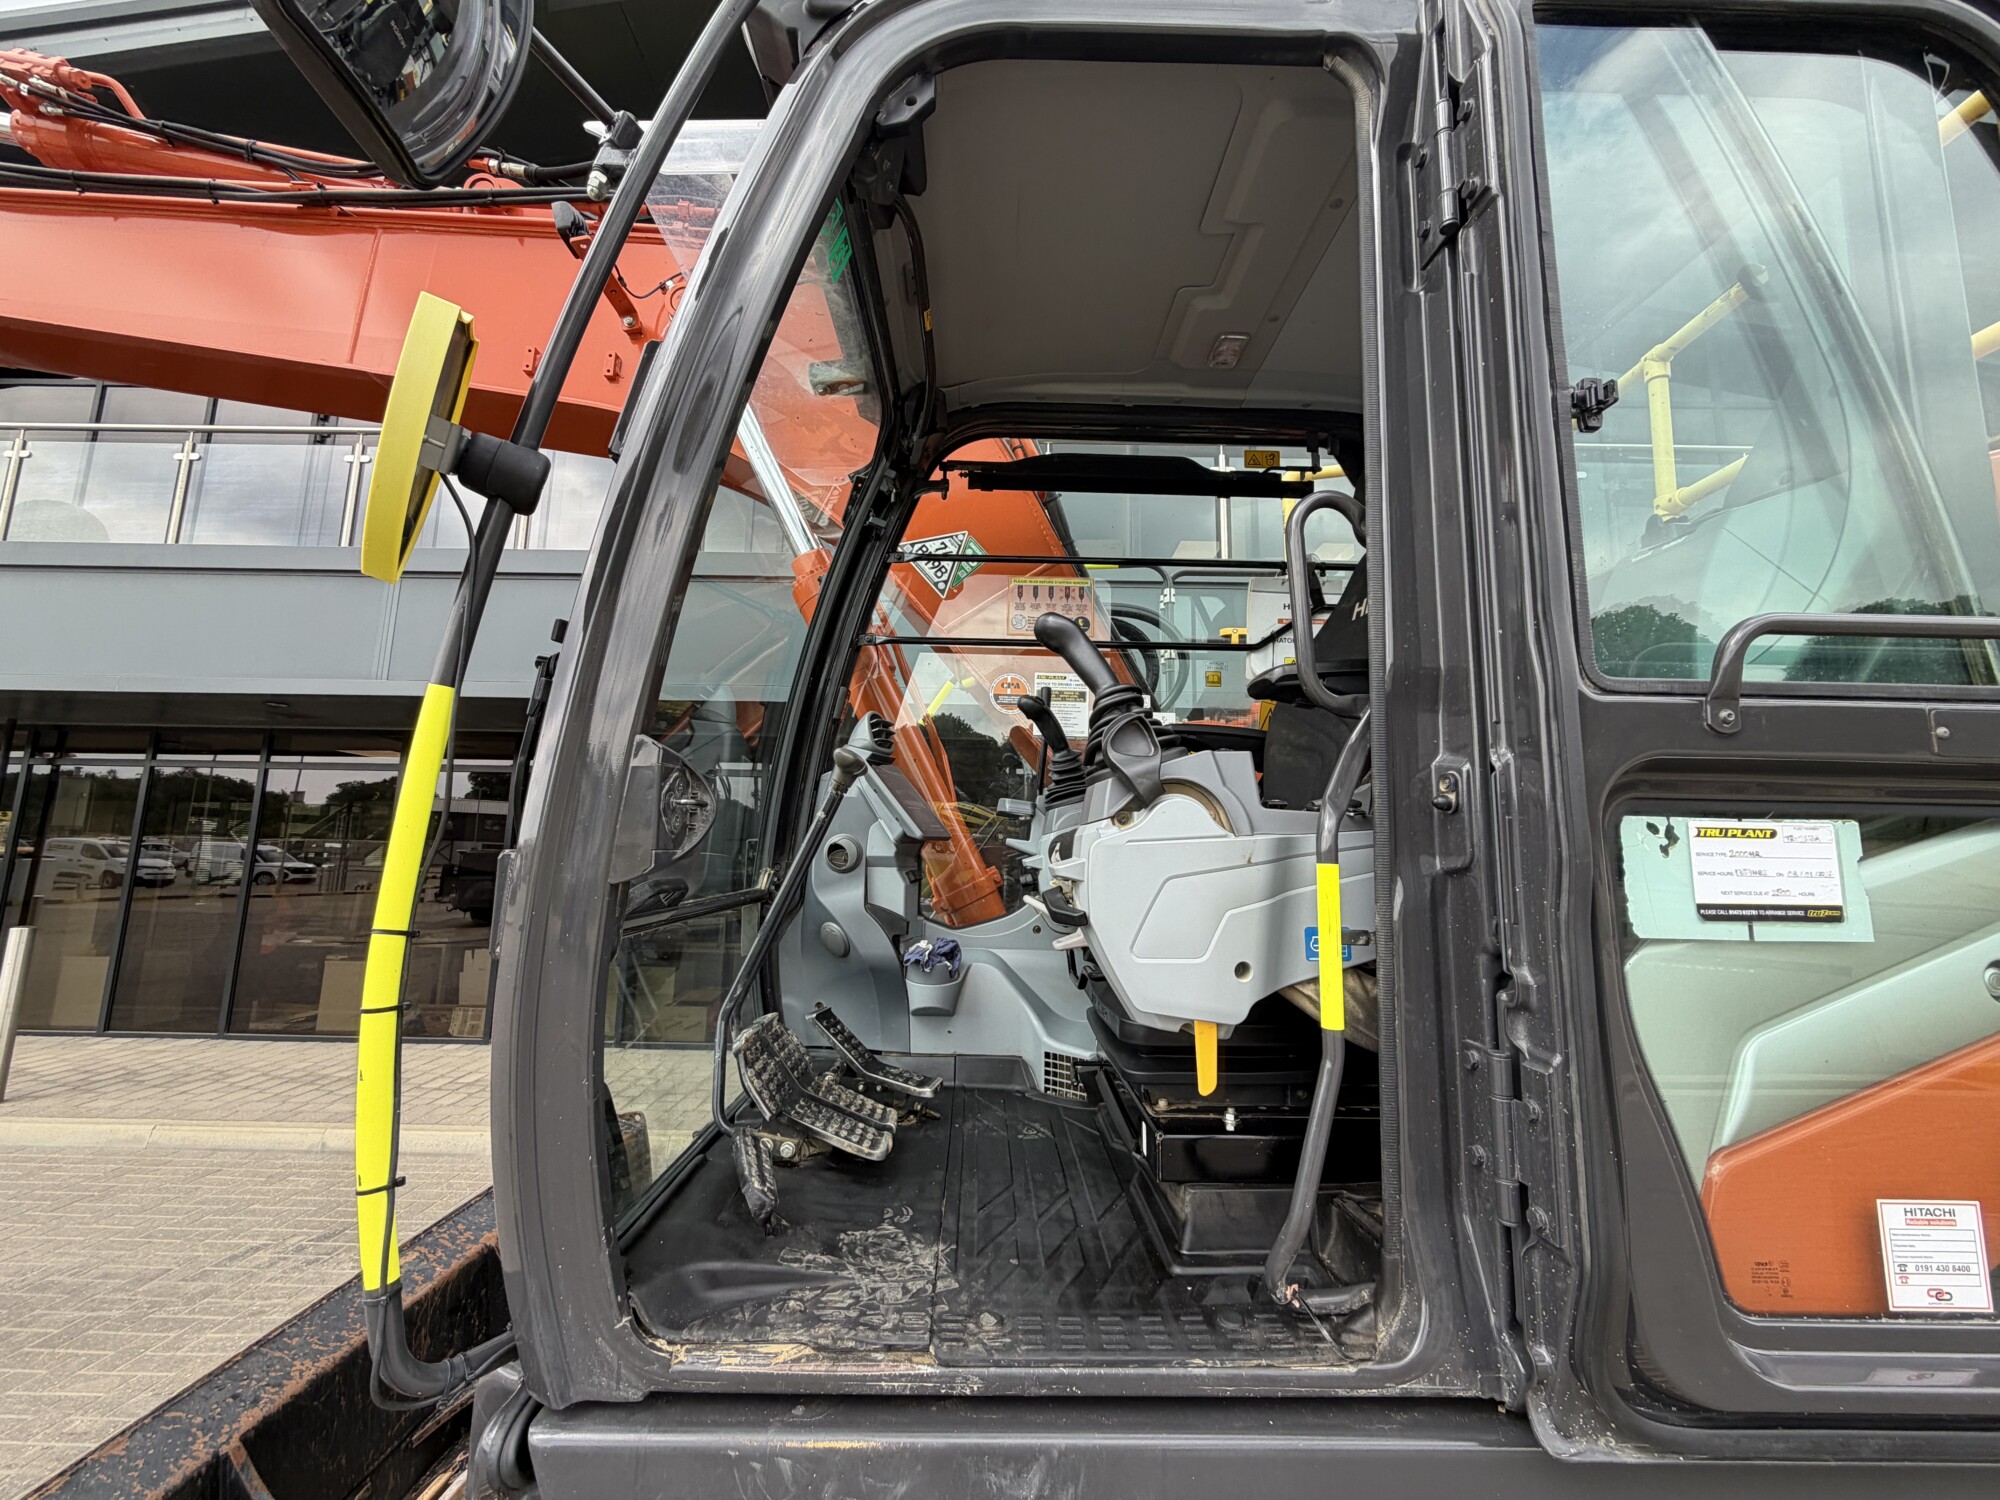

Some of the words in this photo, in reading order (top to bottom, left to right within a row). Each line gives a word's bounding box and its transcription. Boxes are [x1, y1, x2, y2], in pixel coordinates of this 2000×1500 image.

[1000, 682, 1021, 690] CPA
[1698, 828, 1726, 838] TRU
[1726, 828, 1774, 839] PLANT
[1903, 1207, 1957, 1218] HITACHI
[1906, 1218, 1930, 1226] Reliable
[1929, 1219, 1957, 1227] solutions
[1915, 1264, 1934, 1273] 0191
[1935, 1264, 1950, 1273] 430
[1952, 1264, 1971, 1273] 8400
